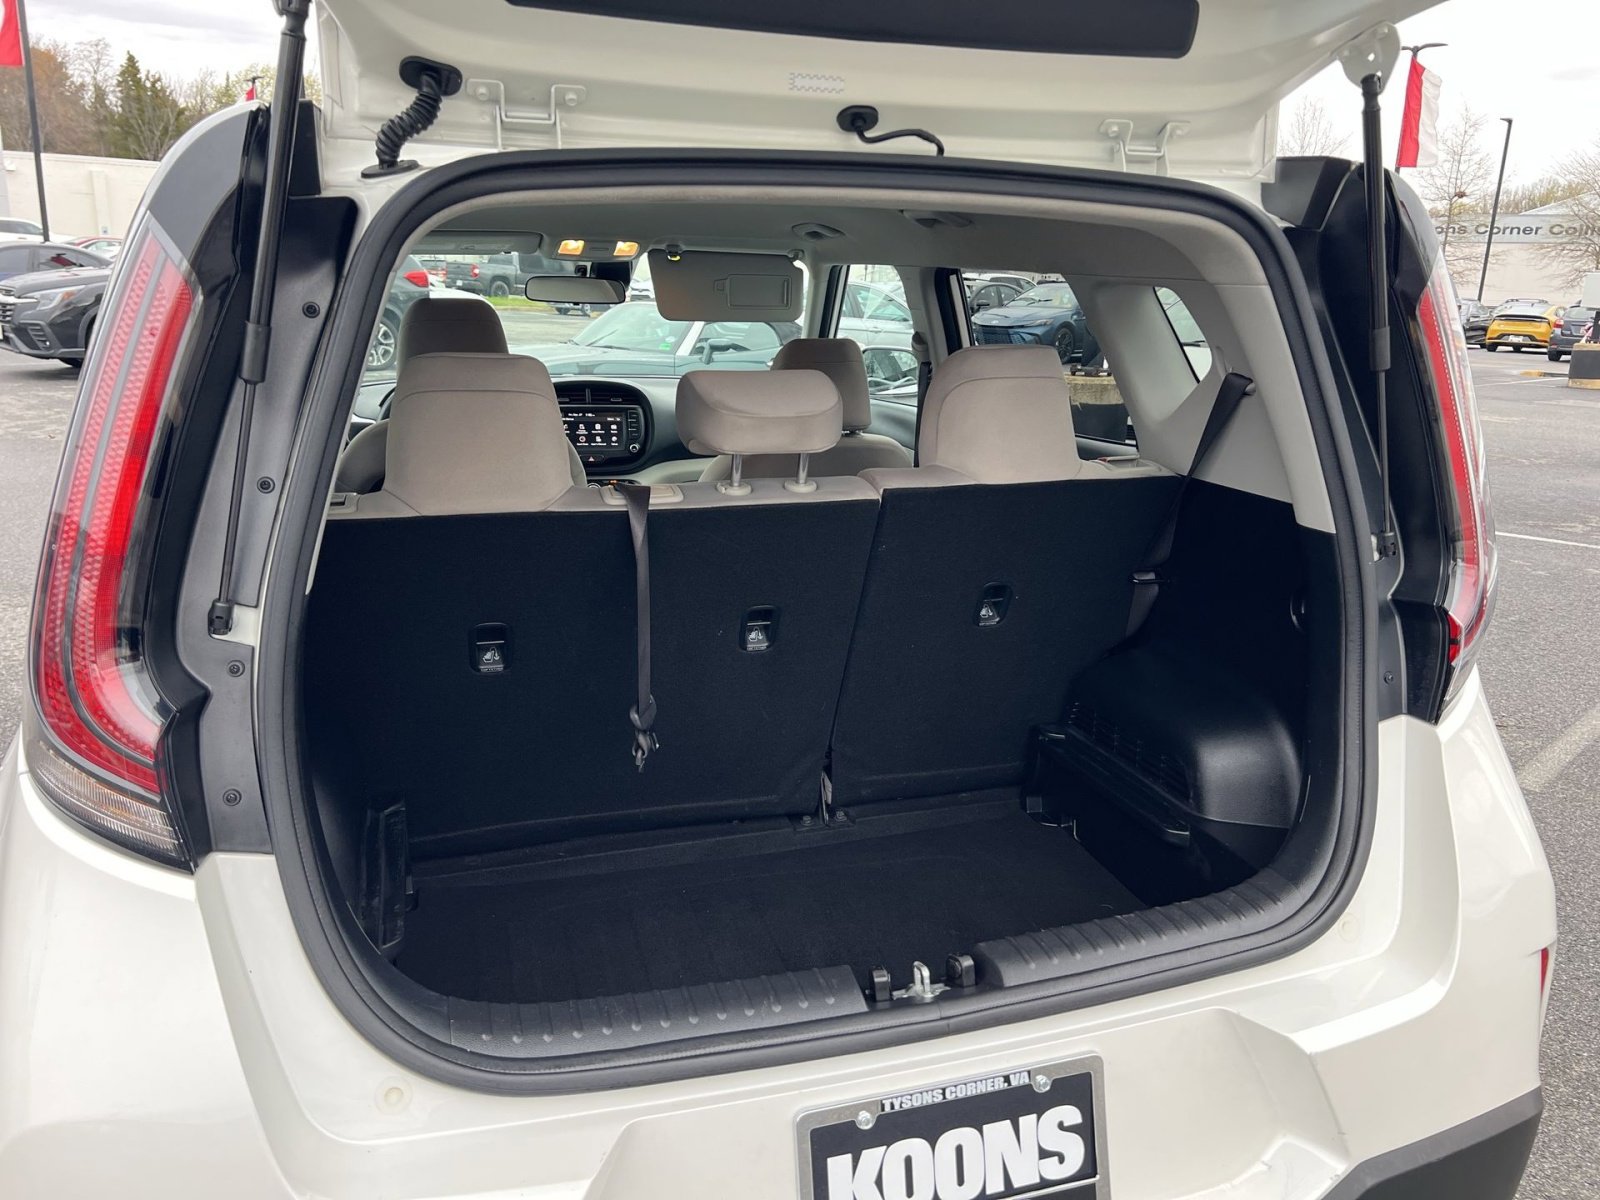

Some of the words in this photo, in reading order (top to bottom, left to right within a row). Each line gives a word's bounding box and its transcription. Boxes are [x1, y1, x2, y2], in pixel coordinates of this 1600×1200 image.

[1435, 225, 1468, 235] ons
[1475, 223, 1542, 235] Corner
[882, 1089, 943, 1112] TYSONS
[1010, 1071, 1030, 1086] VA
[827, 1105, 1085, 1200] KOONS
